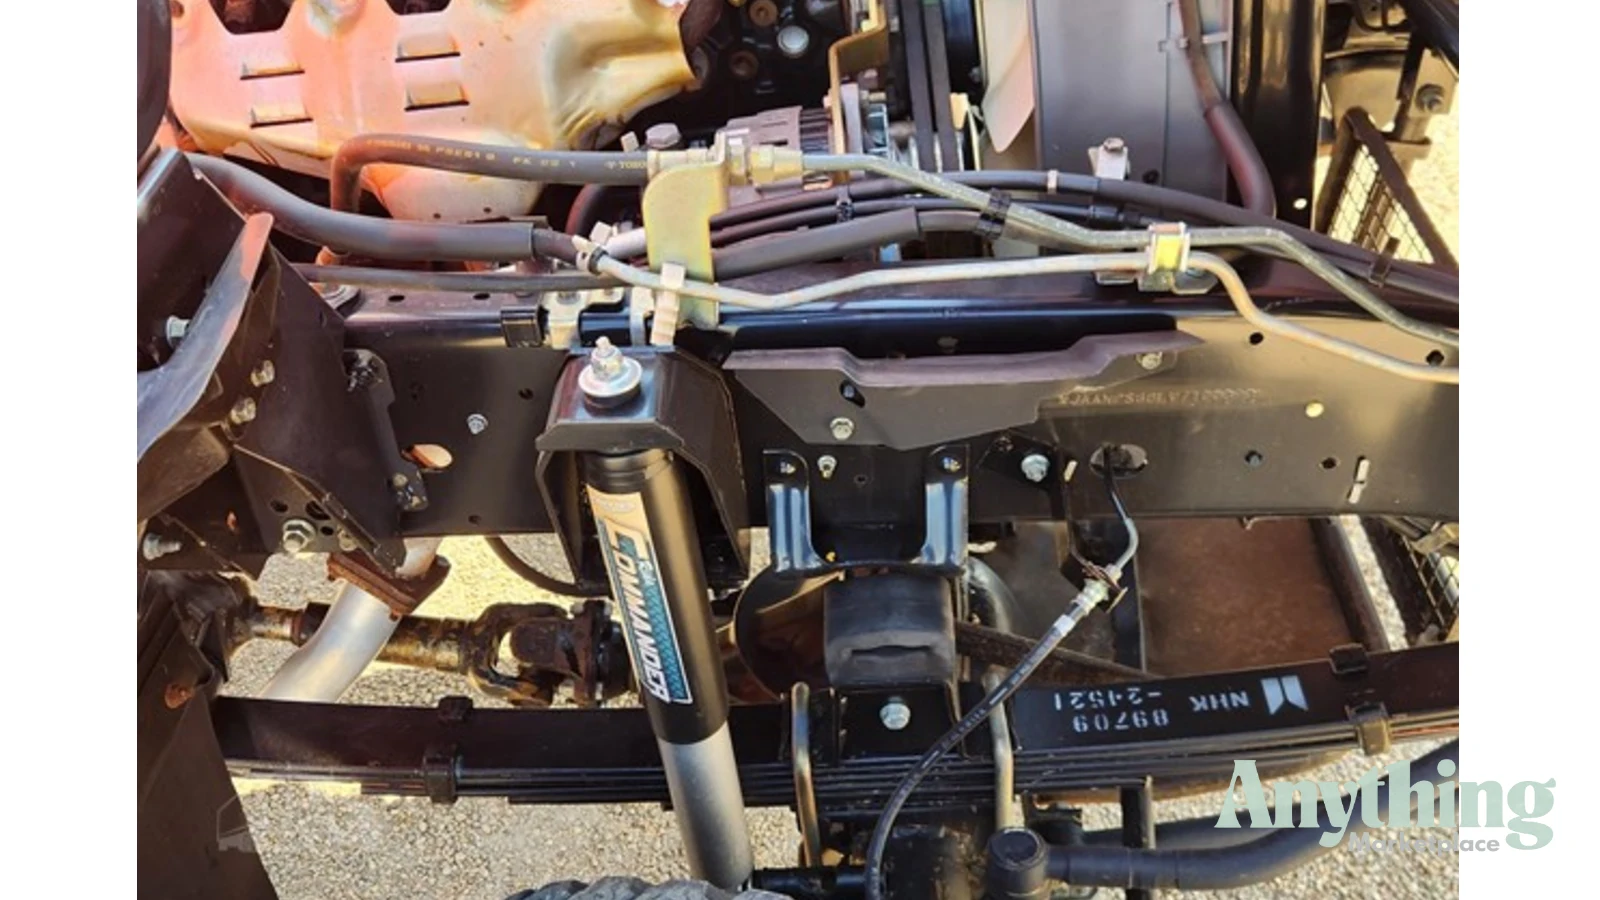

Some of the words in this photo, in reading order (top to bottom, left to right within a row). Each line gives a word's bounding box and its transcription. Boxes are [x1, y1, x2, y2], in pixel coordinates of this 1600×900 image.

[603, 517, 670, 705] COMMANDER
[1189, 690, 1251, 712] NHK
[1072, 708, 1169, 733] 89709
